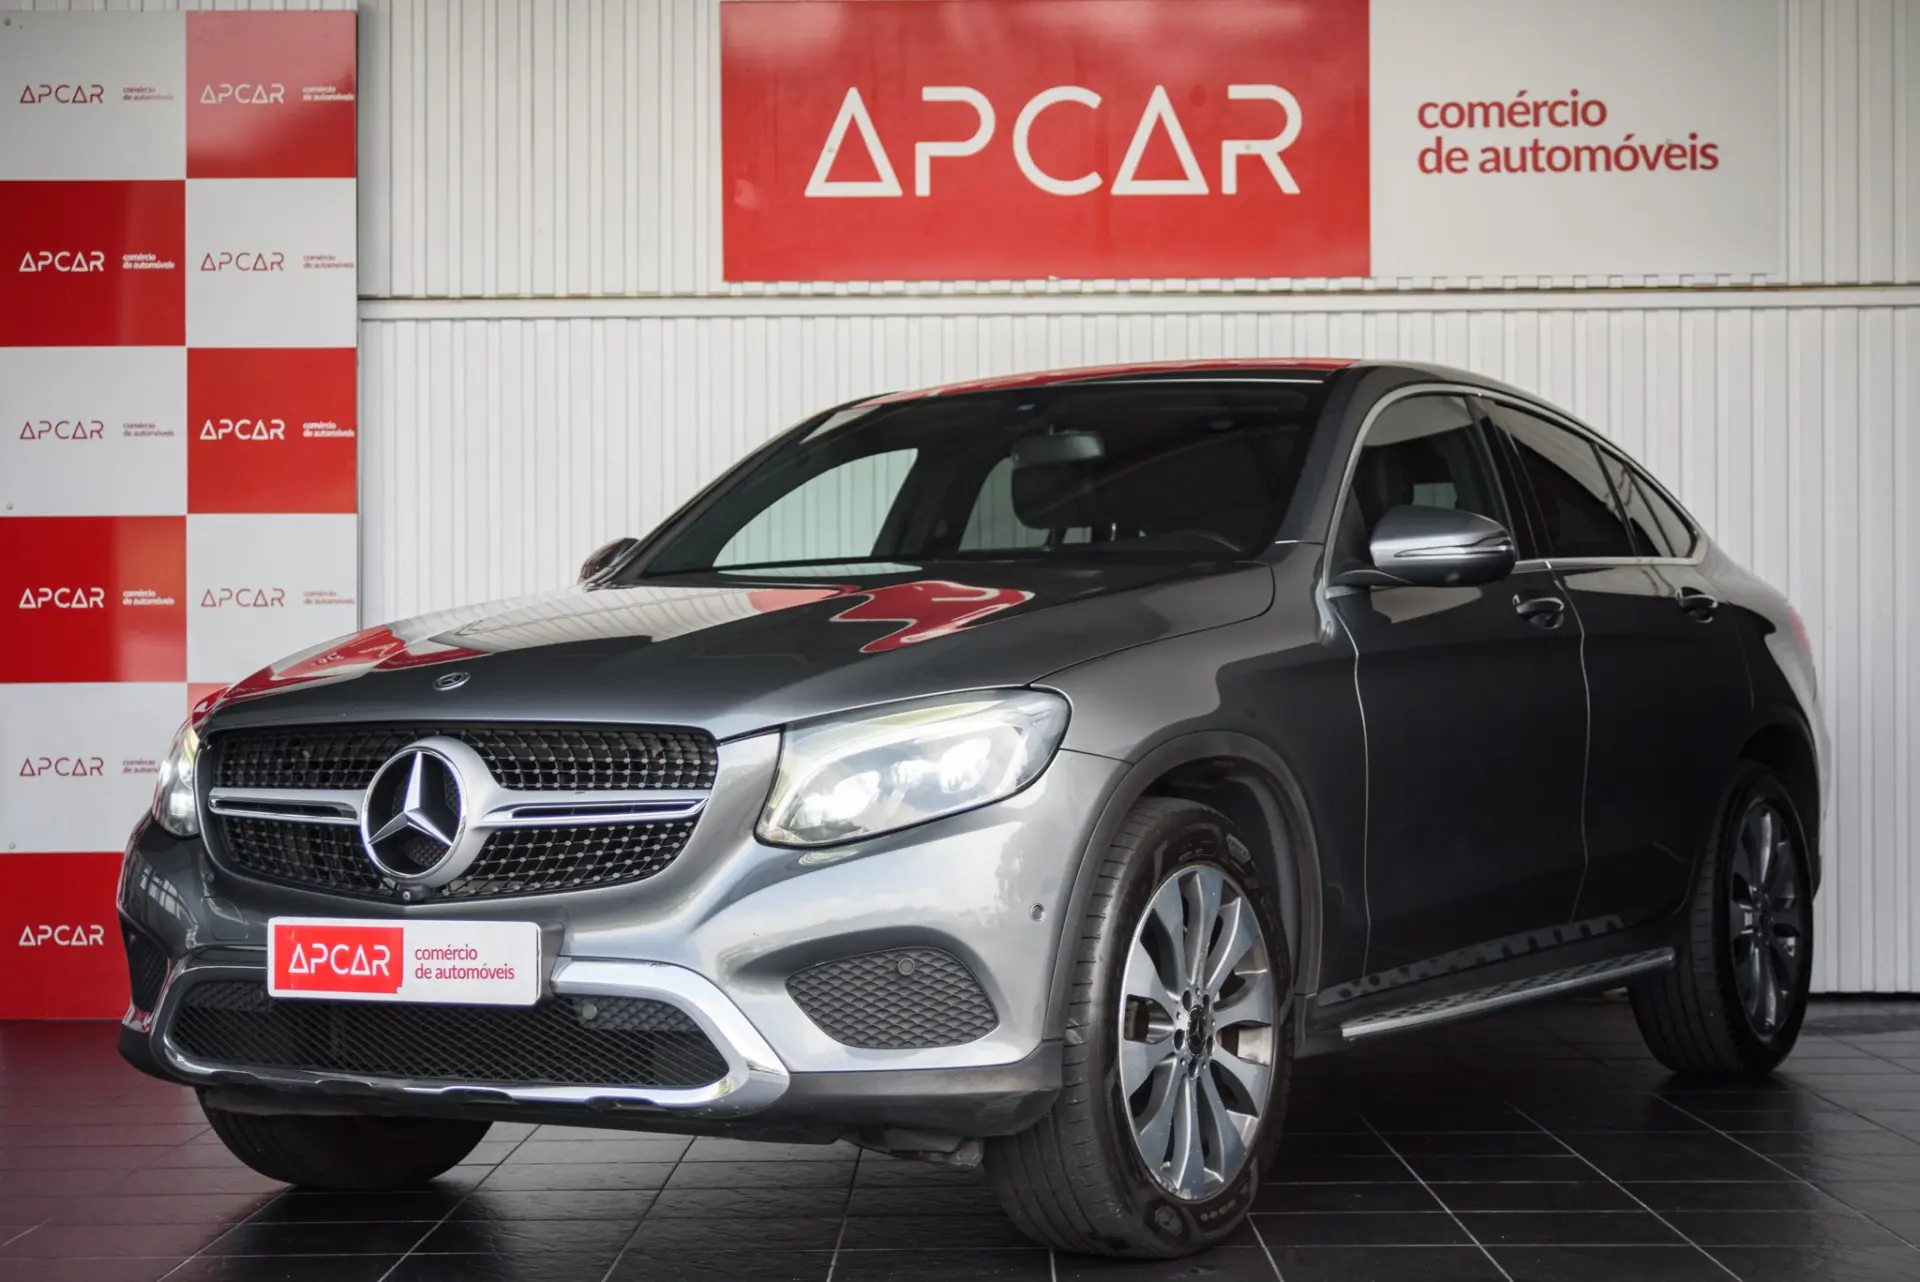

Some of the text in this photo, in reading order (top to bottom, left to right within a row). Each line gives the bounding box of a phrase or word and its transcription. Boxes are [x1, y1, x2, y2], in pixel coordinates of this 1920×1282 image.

[20, 84, 104, 104] APCAR
[200, 83, 285, 105] APCAR
[1418, 89, 1607, 128] comércio
[804, 84, 1302, 197] APCAR
[1418, 132, 1719, 174] de automóveis
[19, 251, 104, 272] APCAR
[201, 252, 285, 272] APCAR
[20, 420, 104, 440] APCAR
[200, 419, 285, 440] APCAR
[19, 587, 104, 608] APCAR
[201, 588, 285, 608] APCAR
[20, 757, 104, 777] APCAR
[19, 925, 104, 946] APCAR
[288, 943, 390, 977] APCAR
[415, 944, 478, 960] comércio
[415, 963, 514, 979] de automóveis
